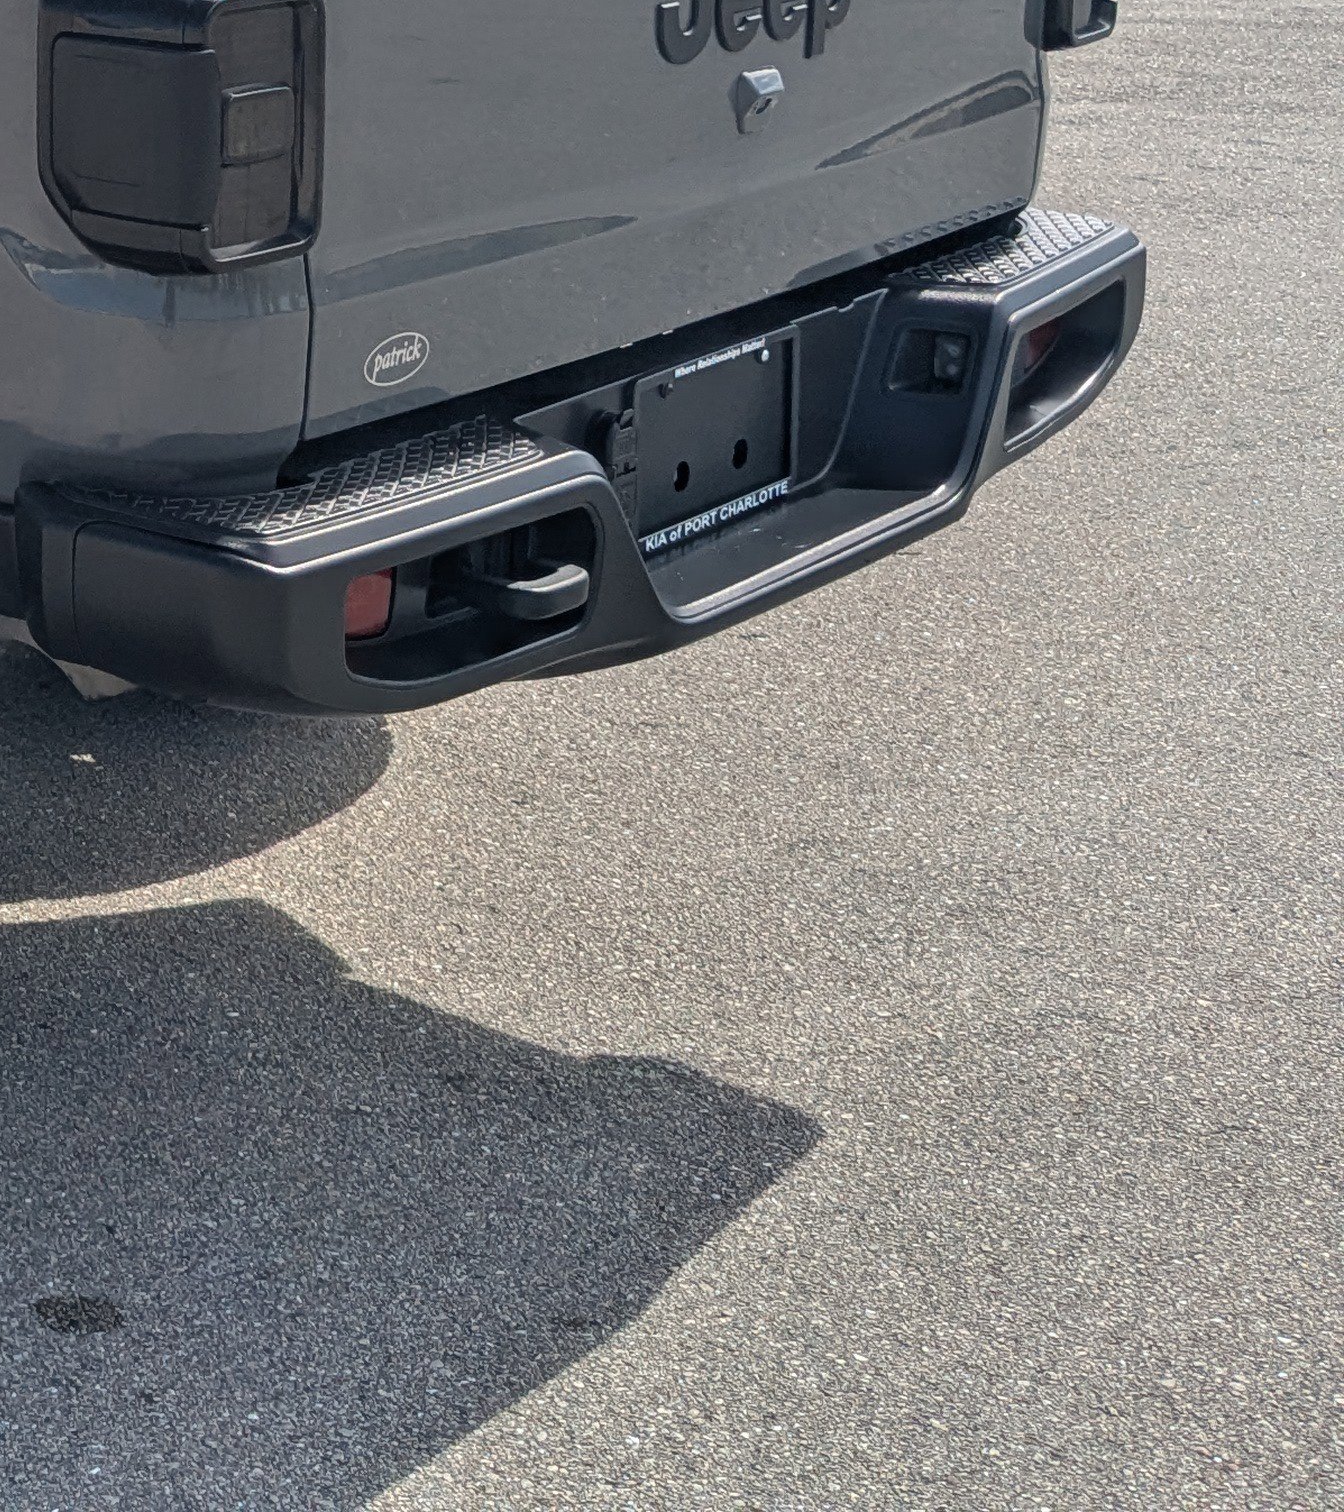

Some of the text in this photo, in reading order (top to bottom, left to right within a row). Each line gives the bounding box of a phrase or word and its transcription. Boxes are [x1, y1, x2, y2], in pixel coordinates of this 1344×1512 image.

[372, 334, 422, 383] patrick
[645, 480, 789, 552] KIA of PORT CHARLOTTE
